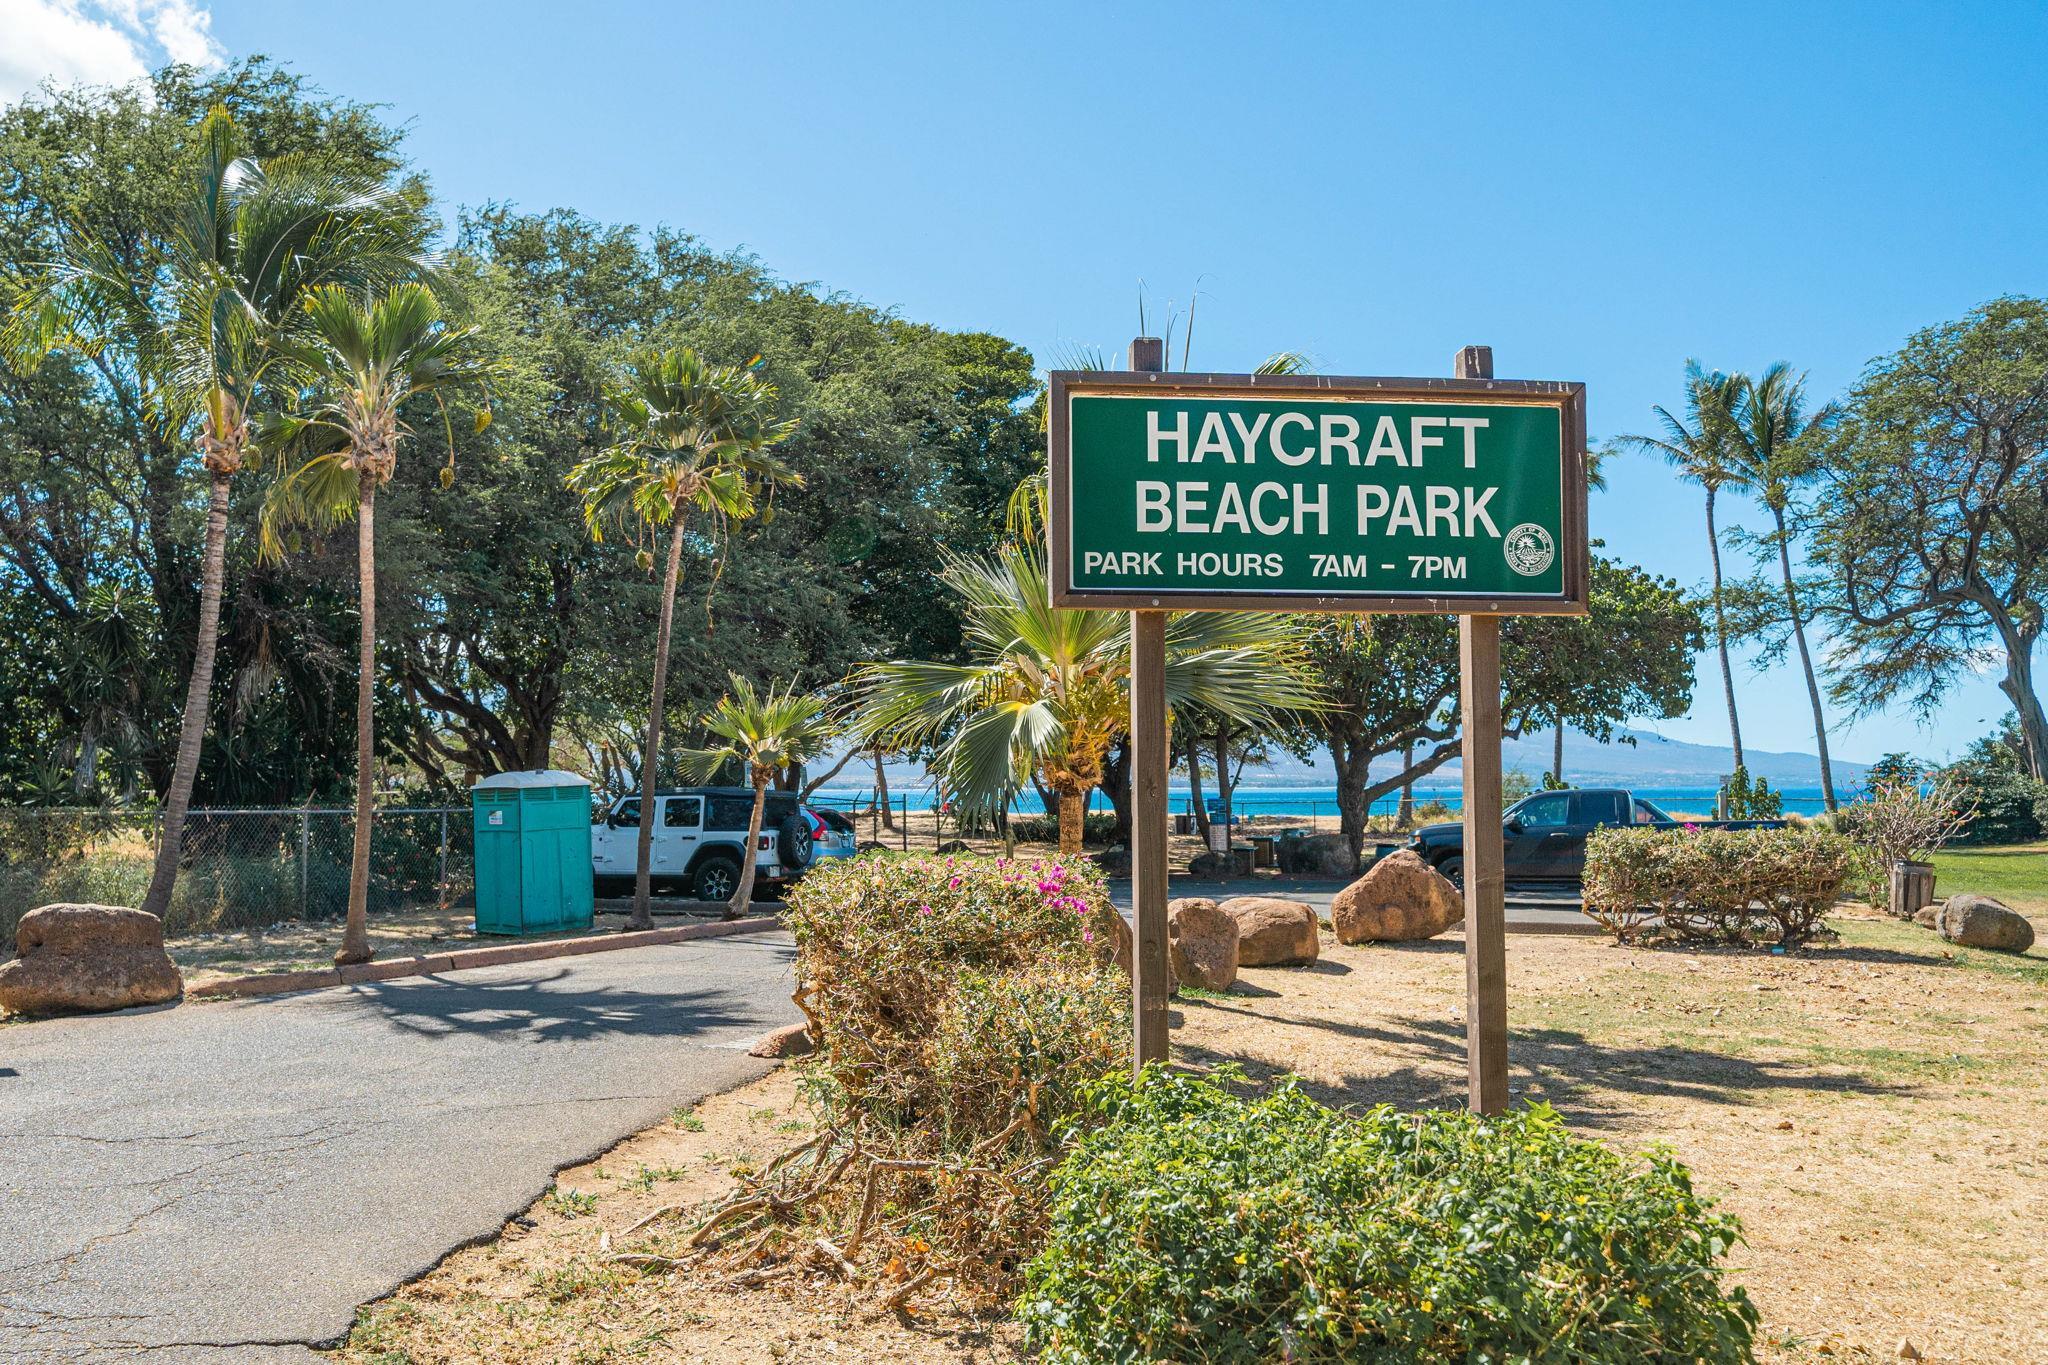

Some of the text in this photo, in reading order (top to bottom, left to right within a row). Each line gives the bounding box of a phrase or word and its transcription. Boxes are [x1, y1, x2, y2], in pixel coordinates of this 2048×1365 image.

[1147, 411, 1490, 468] HAYCRAFT
[1136, 481, 1502, 538] BEACH PARK
[1084, 551, 1164, 575] PARK
[1177, 552, 1284, 577] HOURS
[1309, 554, 1367, 578] 7AM
[1407, 555, 1467, 579] 7PM
